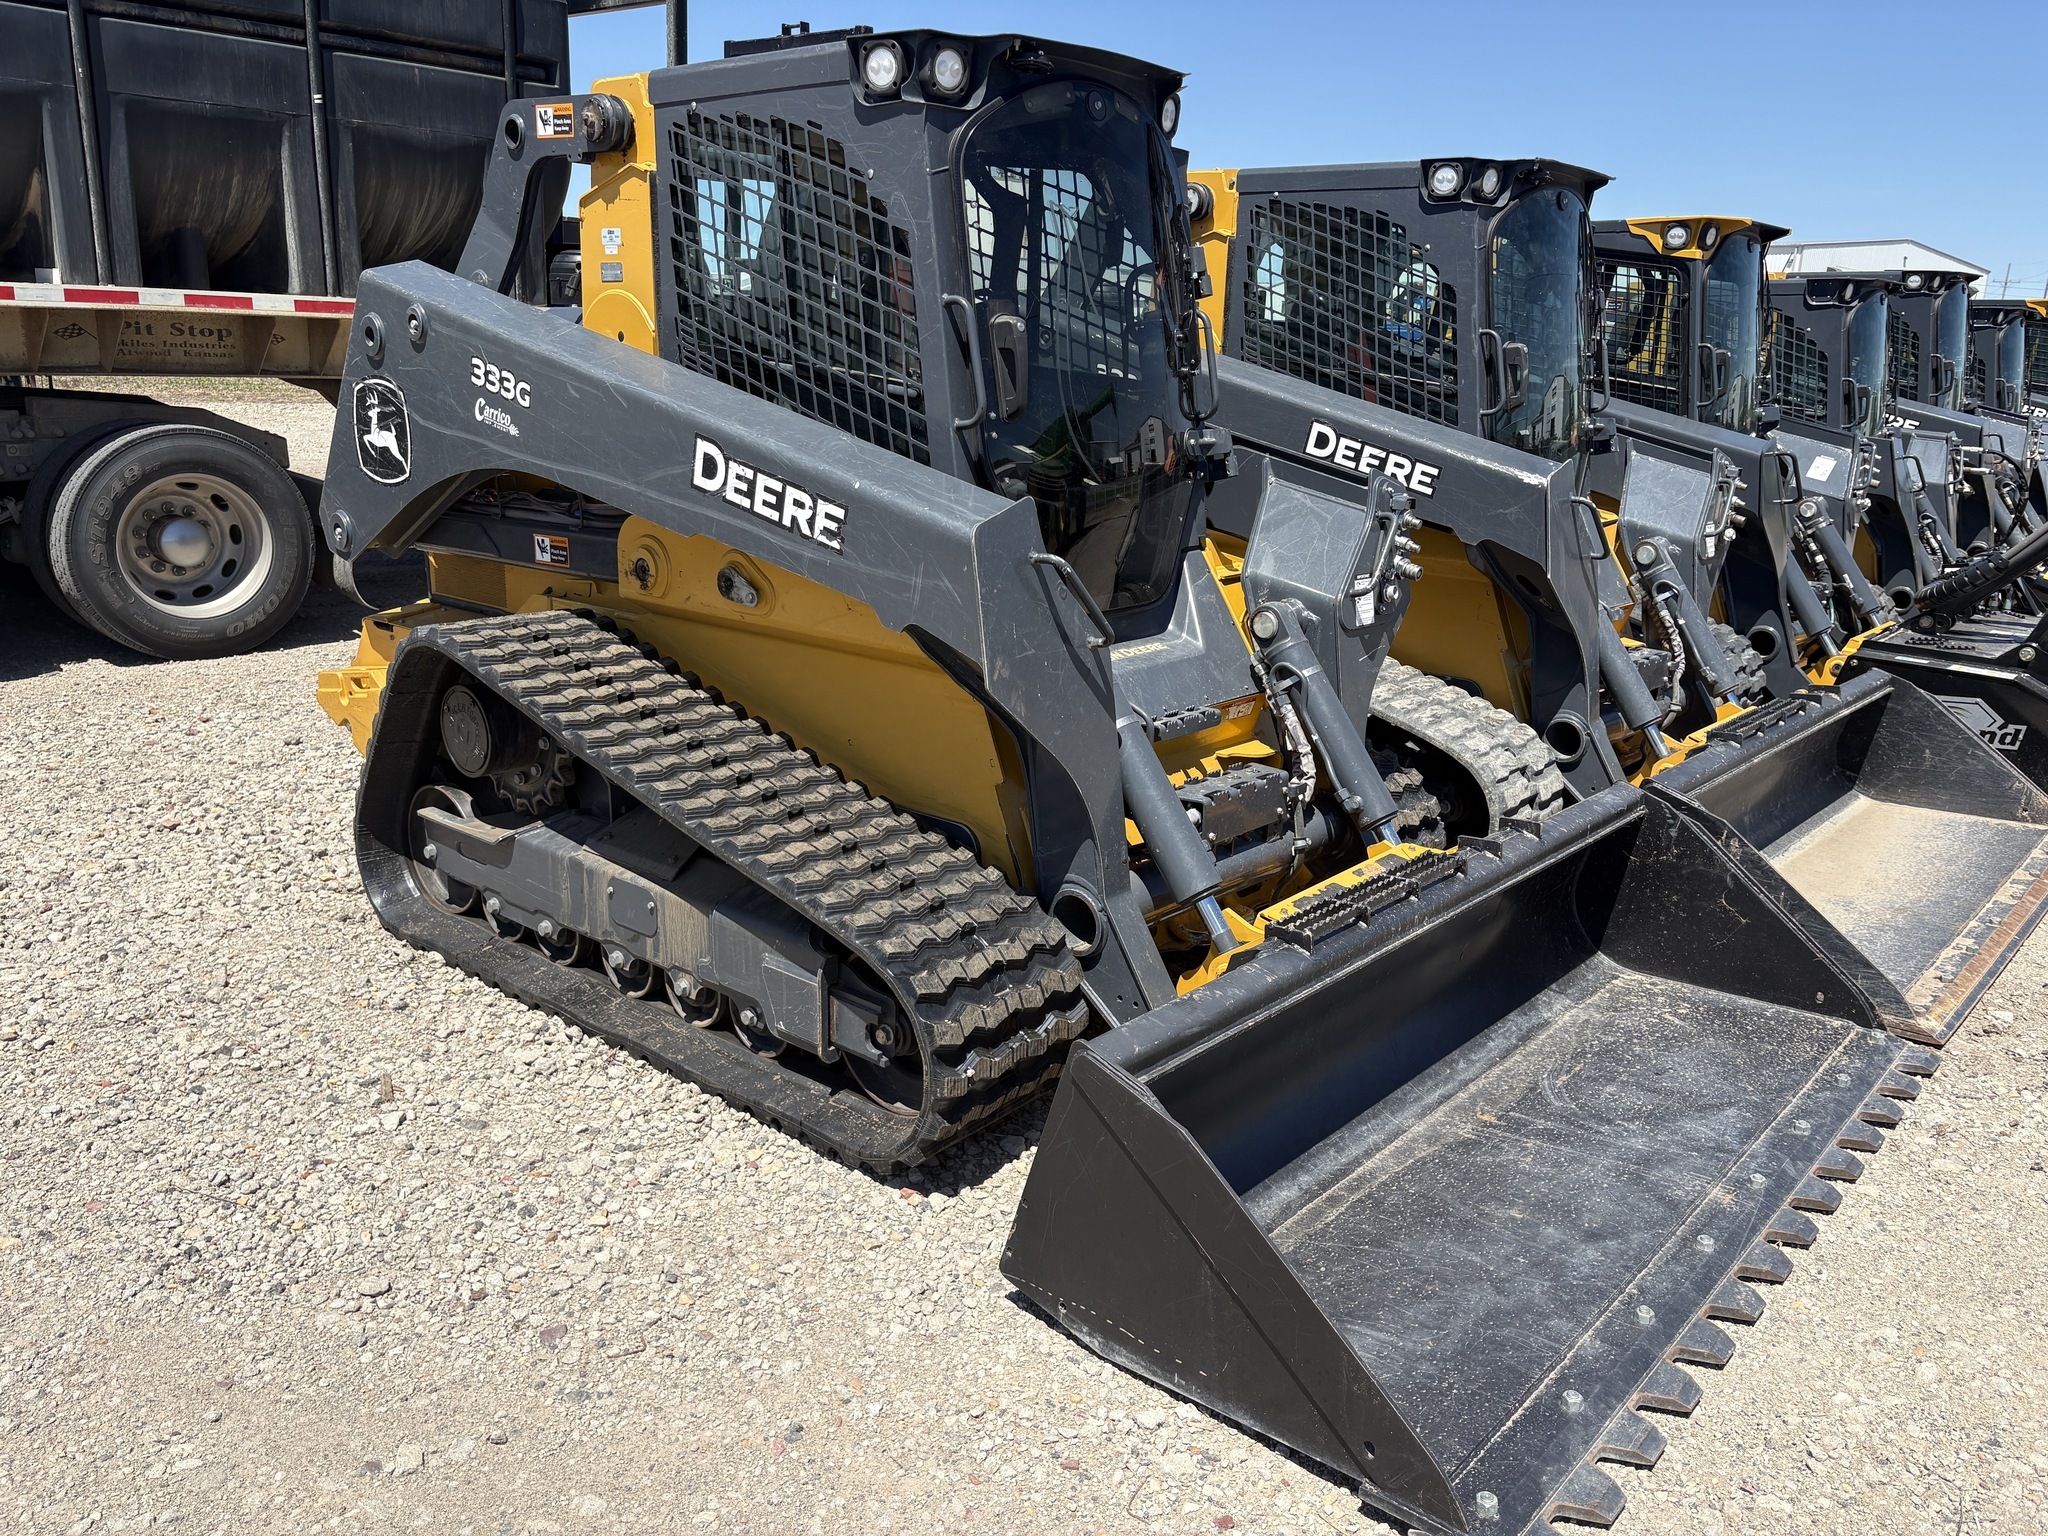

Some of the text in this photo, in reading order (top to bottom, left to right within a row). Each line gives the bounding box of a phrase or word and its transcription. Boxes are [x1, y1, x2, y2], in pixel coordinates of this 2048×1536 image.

[117, 339, 236, 350] kiles Industries
[121, 320, 232, 342] Pit Stop
[116, 348, 235, 358] Atwood Kansas
[470, 355, 531, 409] 333G
[474, 397, 512, 427] Carrico
[1304, 420, 1440, 497] DEERE
[691, 434, 847, 553] DEERE
